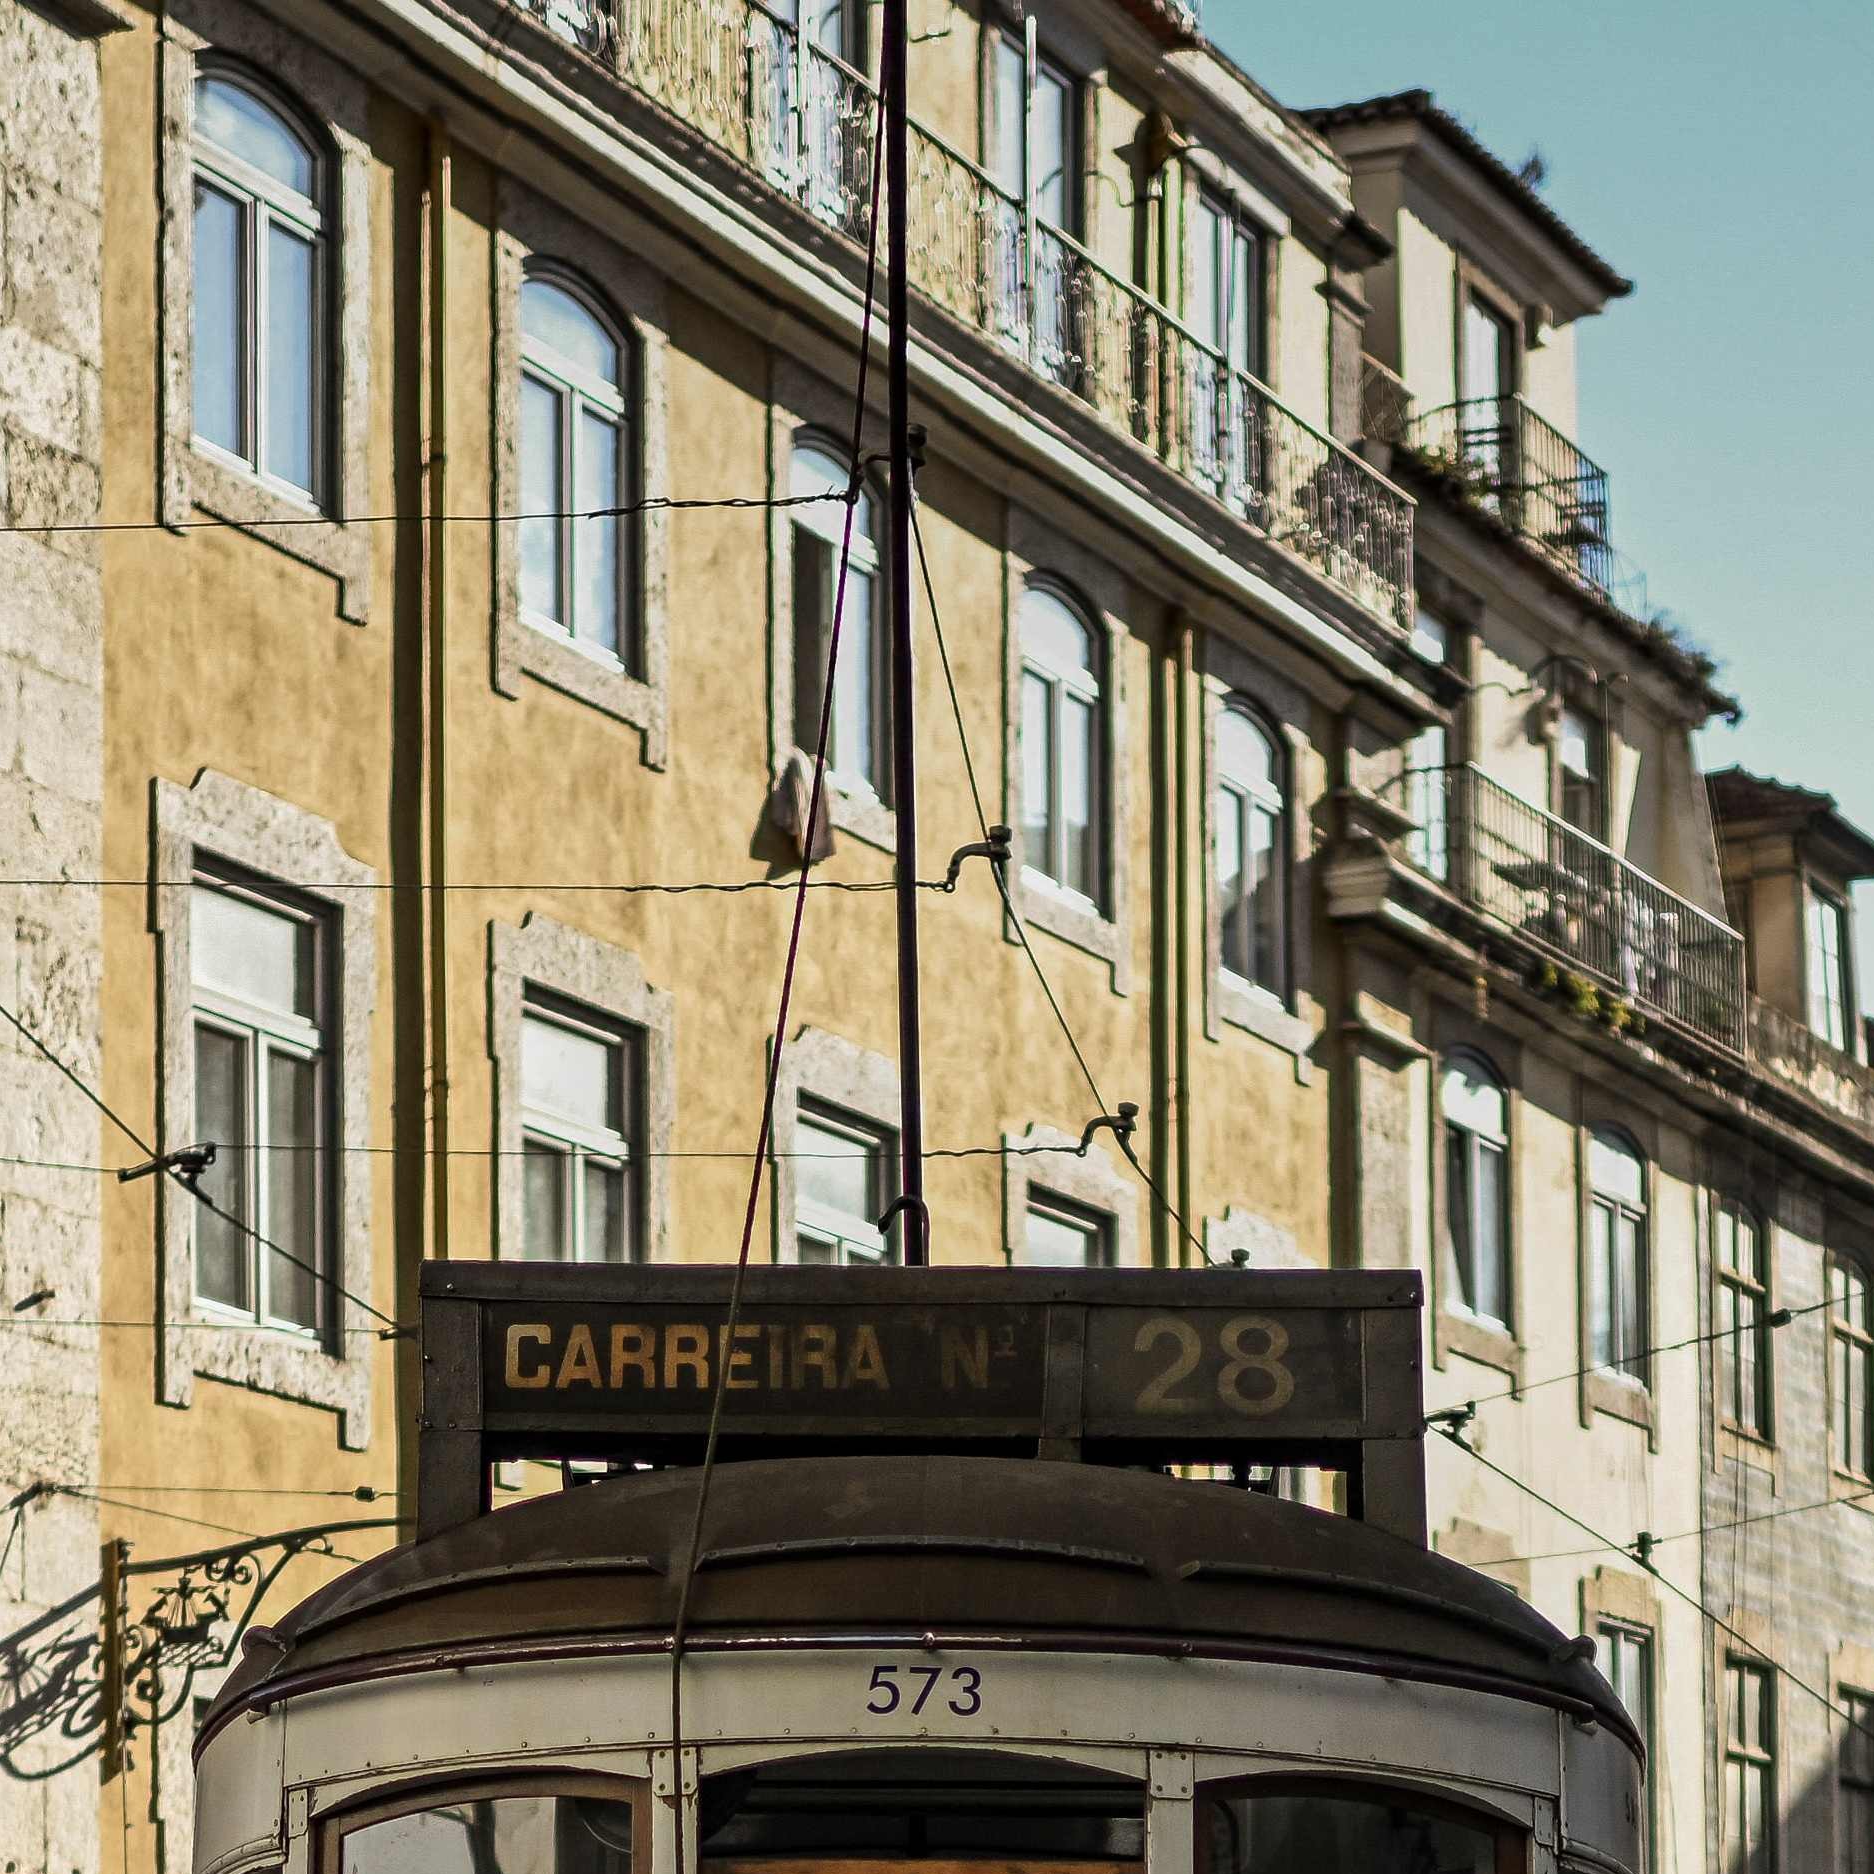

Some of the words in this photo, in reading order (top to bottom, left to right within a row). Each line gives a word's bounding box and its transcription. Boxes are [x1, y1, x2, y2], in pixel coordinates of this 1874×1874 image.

[504, 1322, 890, 1390] CARREIRA
[1133, 1316, 1296, 1416] 28
[866, 1664, 982, 1717] 573
